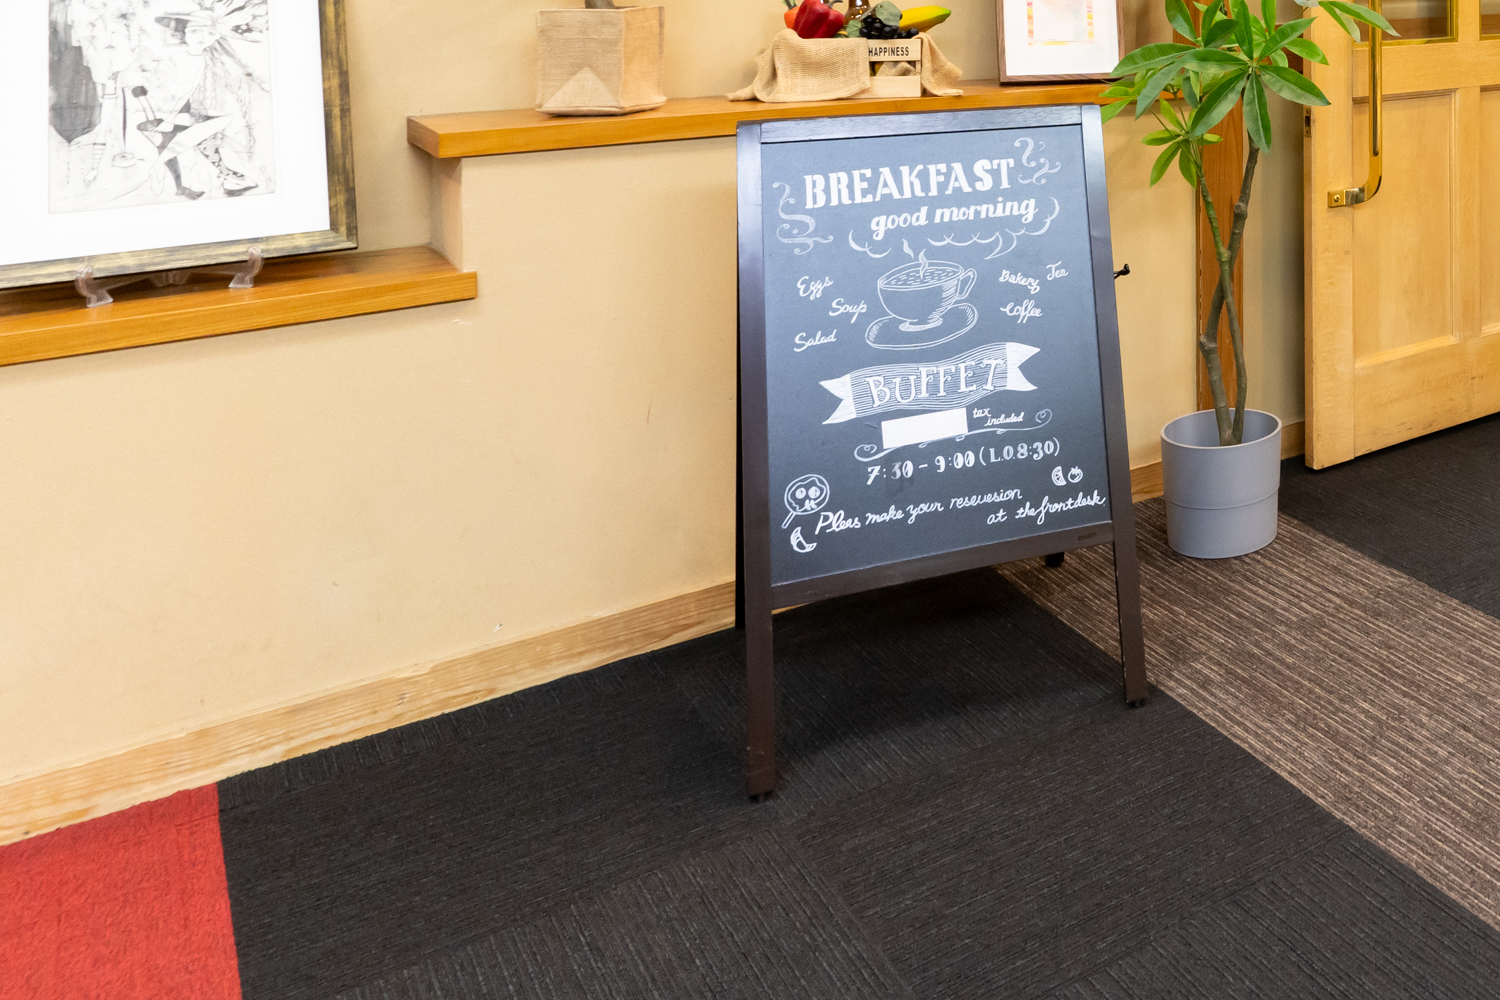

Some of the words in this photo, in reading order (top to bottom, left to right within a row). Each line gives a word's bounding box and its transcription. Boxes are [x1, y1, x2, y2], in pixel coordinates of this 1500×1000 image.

[868, 46, 909, 57] HAPPINESS
[803, 158, 1015, 209] BREAKFAST
[870, 206, 928, 241] good
[934, 197, 1039, 224] morning
[998, 269, 1041, 295] Bakery
[1045, 260, 1069, 281] Tea
[796, 275, 834, 301] Eggs
[828, 297, 868, 324] Soup
[999, 299, 1043, 324] Coffee
[793, 328, 837, 353] Salad
[864, 358, 1008, 408] BUFFET
[972, 407, 992, 419] tax
[983, 411, 1025, 427] included
[866, 460, 914, 486] 7:30
[934, 450, 976, 473] 9:00
[865, 505, 905, 525] make
[906, 501, 944, 525] your
[986, 508, 1008, 525] at
